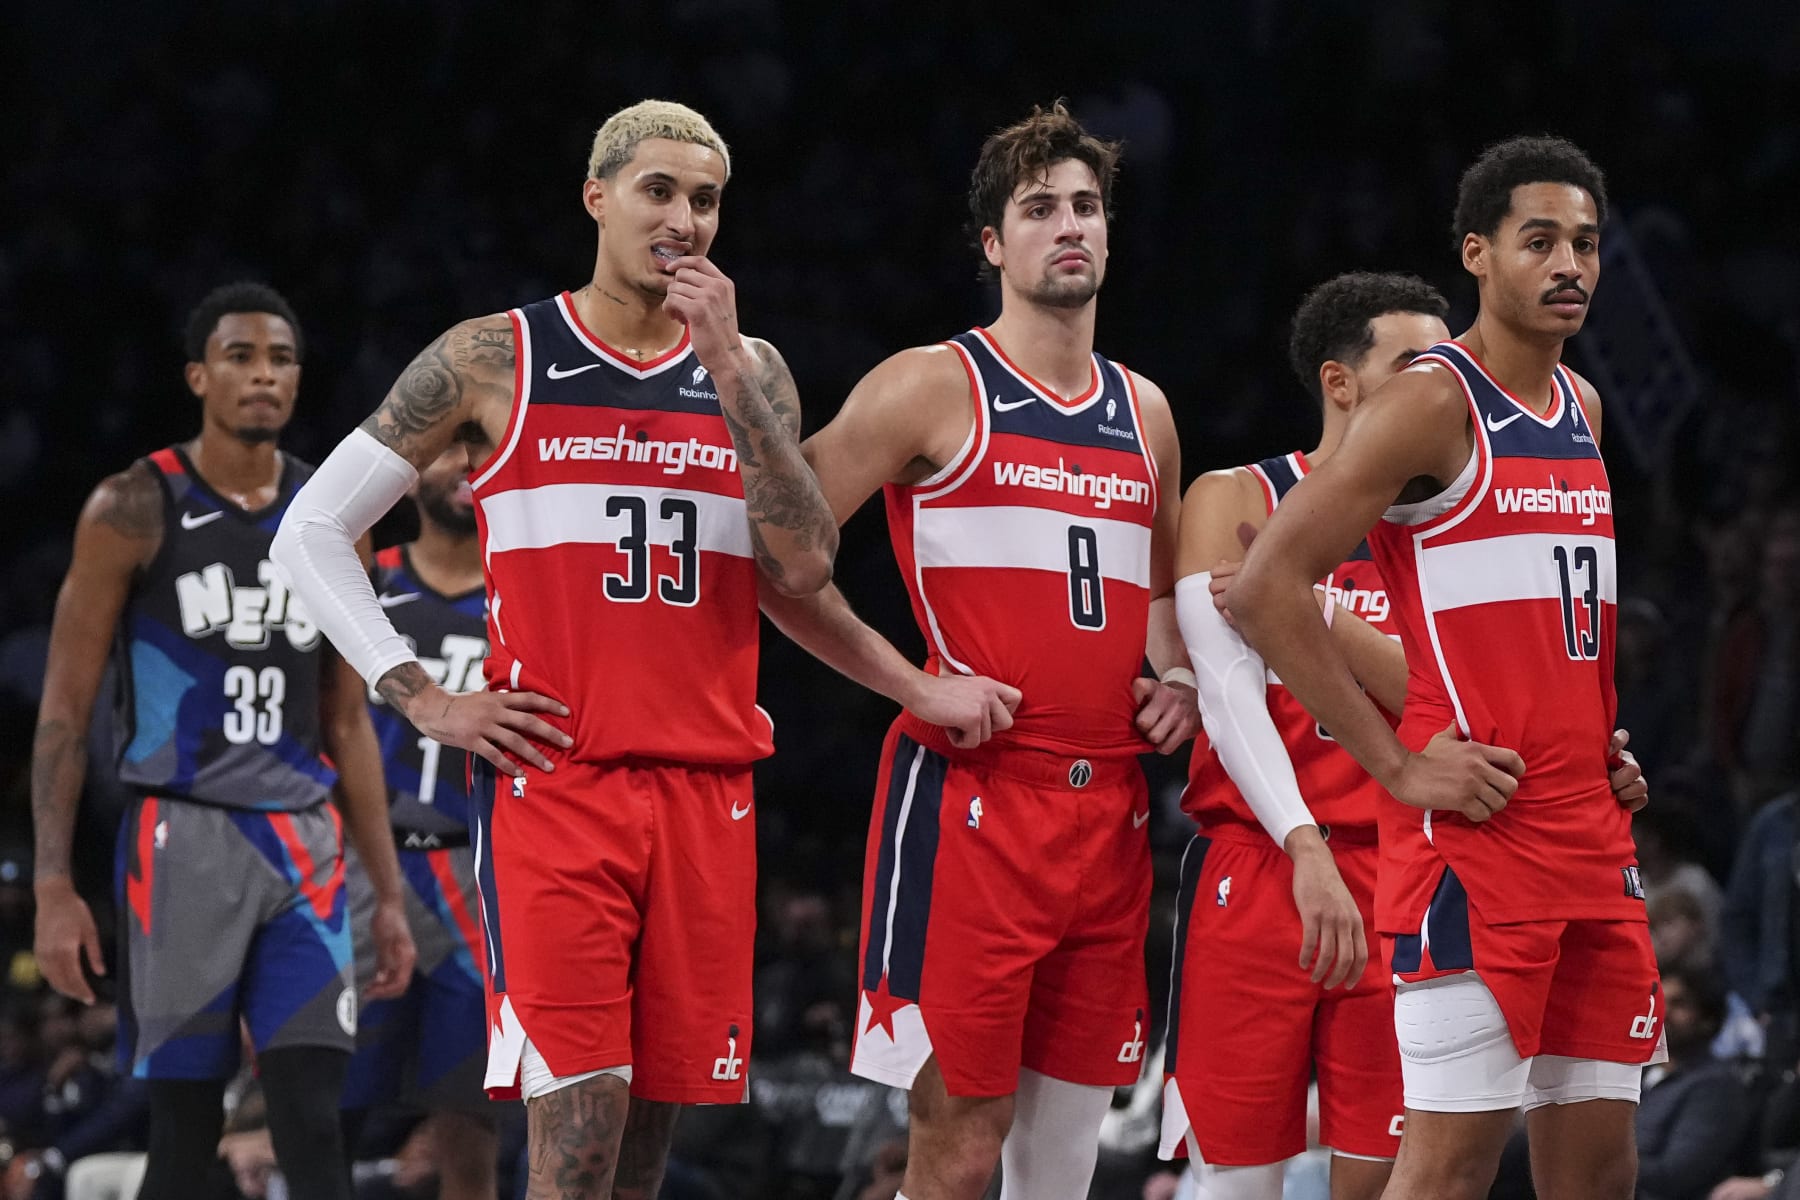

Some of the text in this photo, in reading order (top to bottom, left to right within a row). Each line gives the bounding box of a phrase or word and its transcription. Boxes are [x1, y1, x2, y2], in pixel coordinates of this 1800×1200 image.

[538, 424, 736, 475] washington
[1098, 423, 1134, 440] Robinhood
[994, 457, 1149, 509] washington
[1494, 474, 1611, 526] washington
[602, 495, 700, 608] 33
[1067, 524, 1106, 631] 8
[1553, 544, 1602, 661] 13
[223, 665, 286, 745] 33
[417, 736, 441, 804] 1
[712, 1037, 743, 1081] dc
